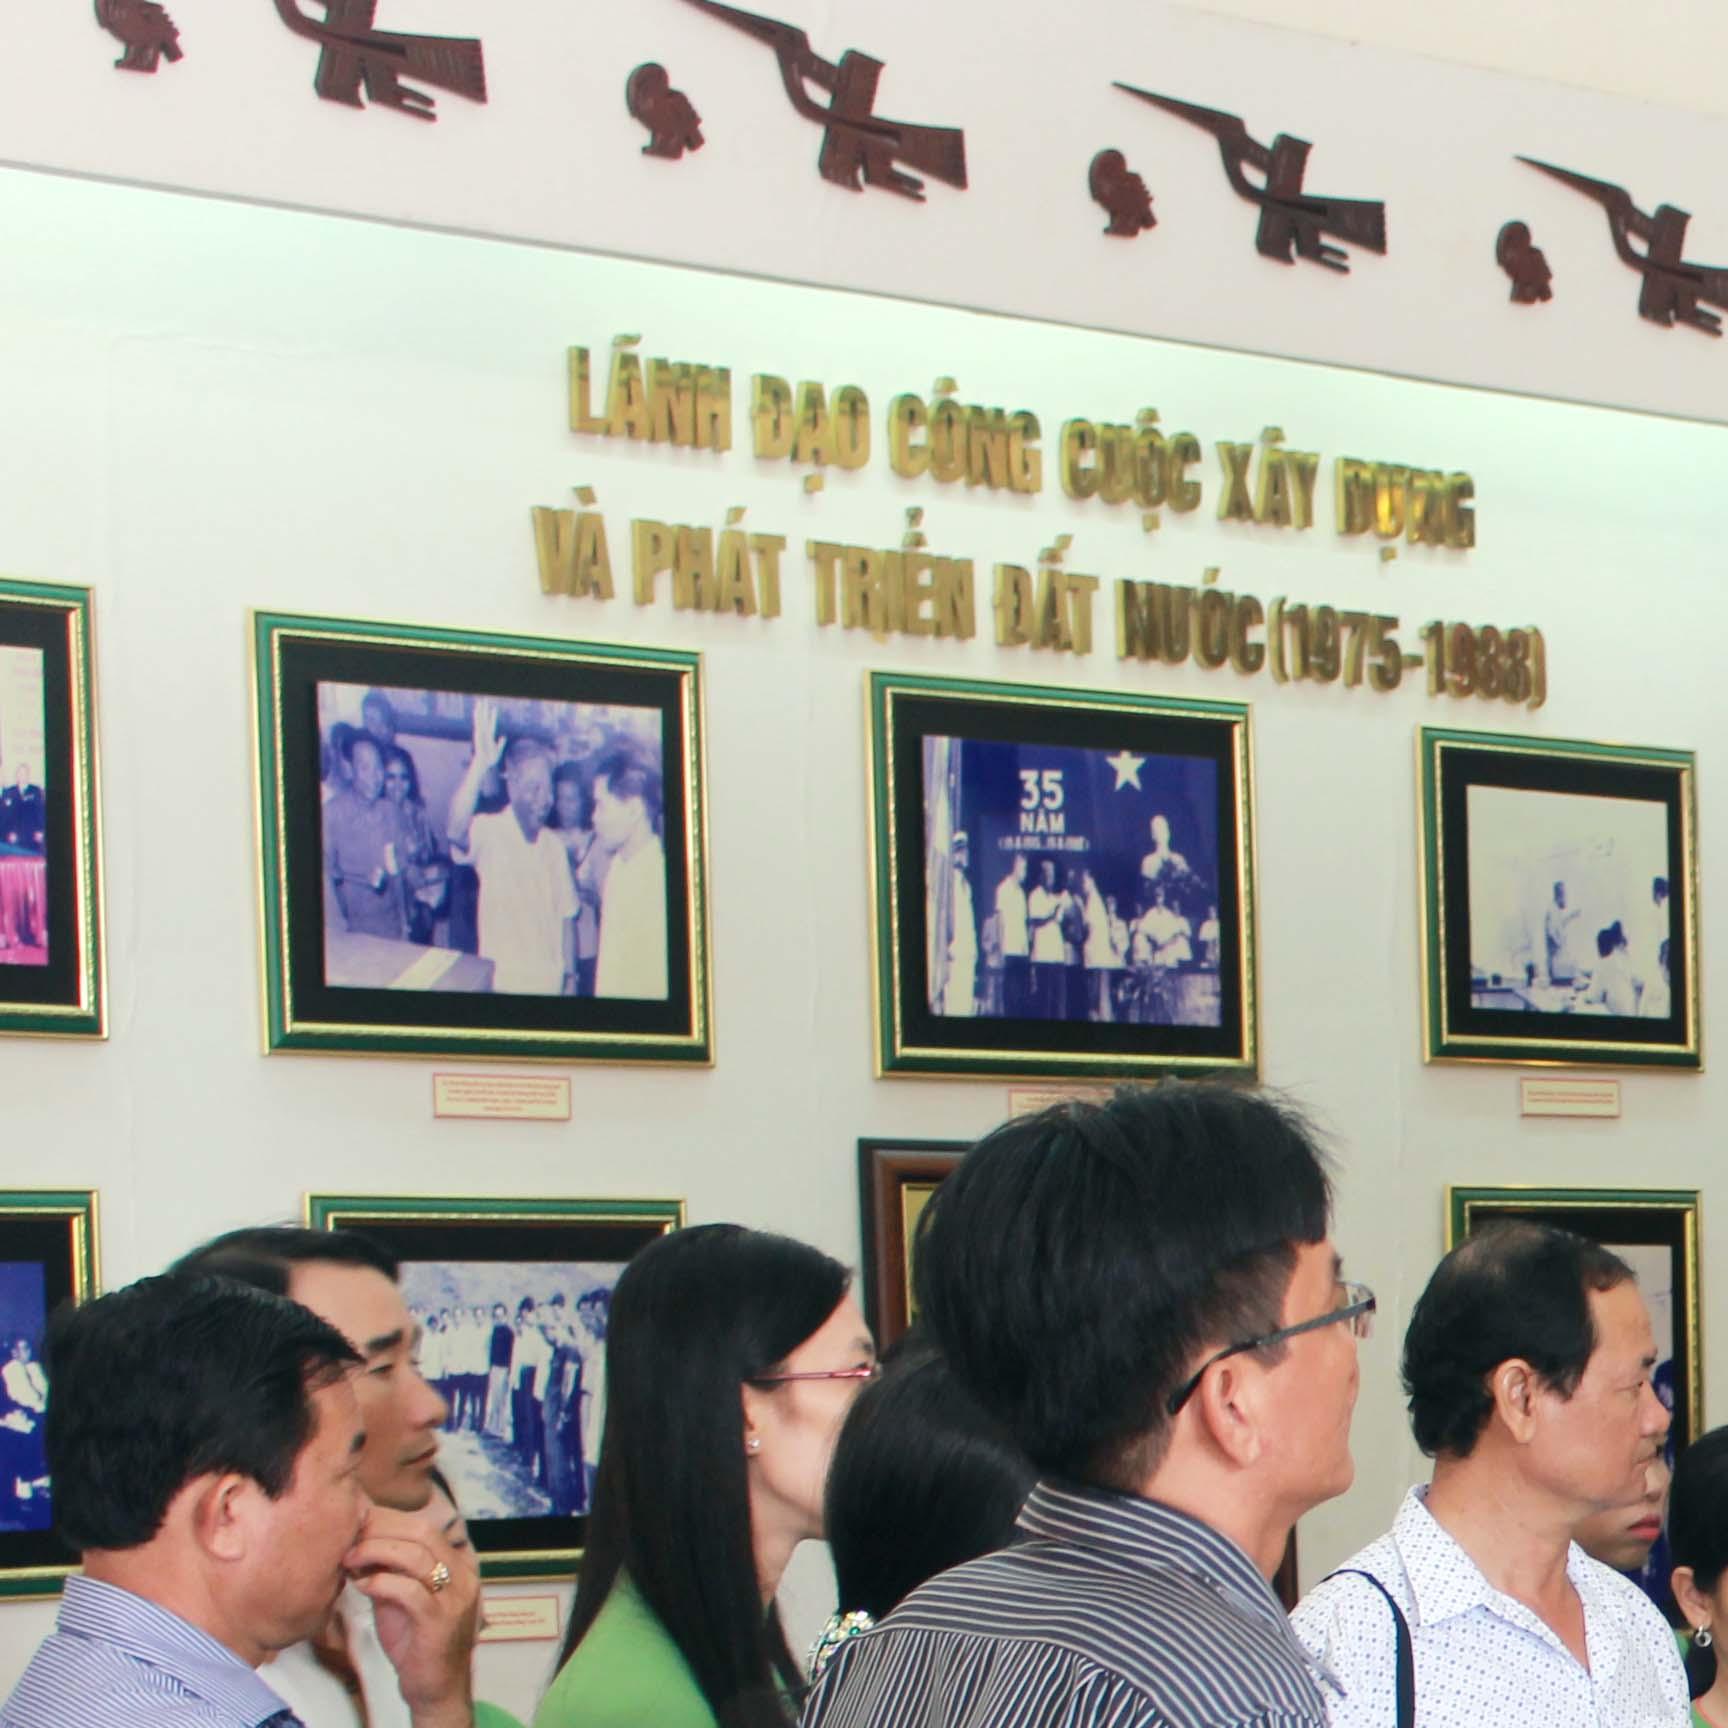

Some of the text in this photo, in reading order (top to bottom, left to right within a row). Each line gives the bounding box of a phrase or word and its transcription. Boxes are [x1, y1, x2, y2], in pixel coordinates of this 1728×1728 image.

[566, 334, 732, 453] LÃNH
[749, 373, 872, 494] ĐẠO
[887, 376, 1043, 496] CÔNG
[1060, 407, 1202, 534] CUỘC
[1215, 425, 1320, 531] XÂY
[531, 484, 616, 602] VÀ
[630, 505, 787, 621] PHÁT
[804, 504, 978, 645] TRIỂN
[992, 532, 1101, 658] ĐẤT
[1018, 769, 1065, 810] 35
